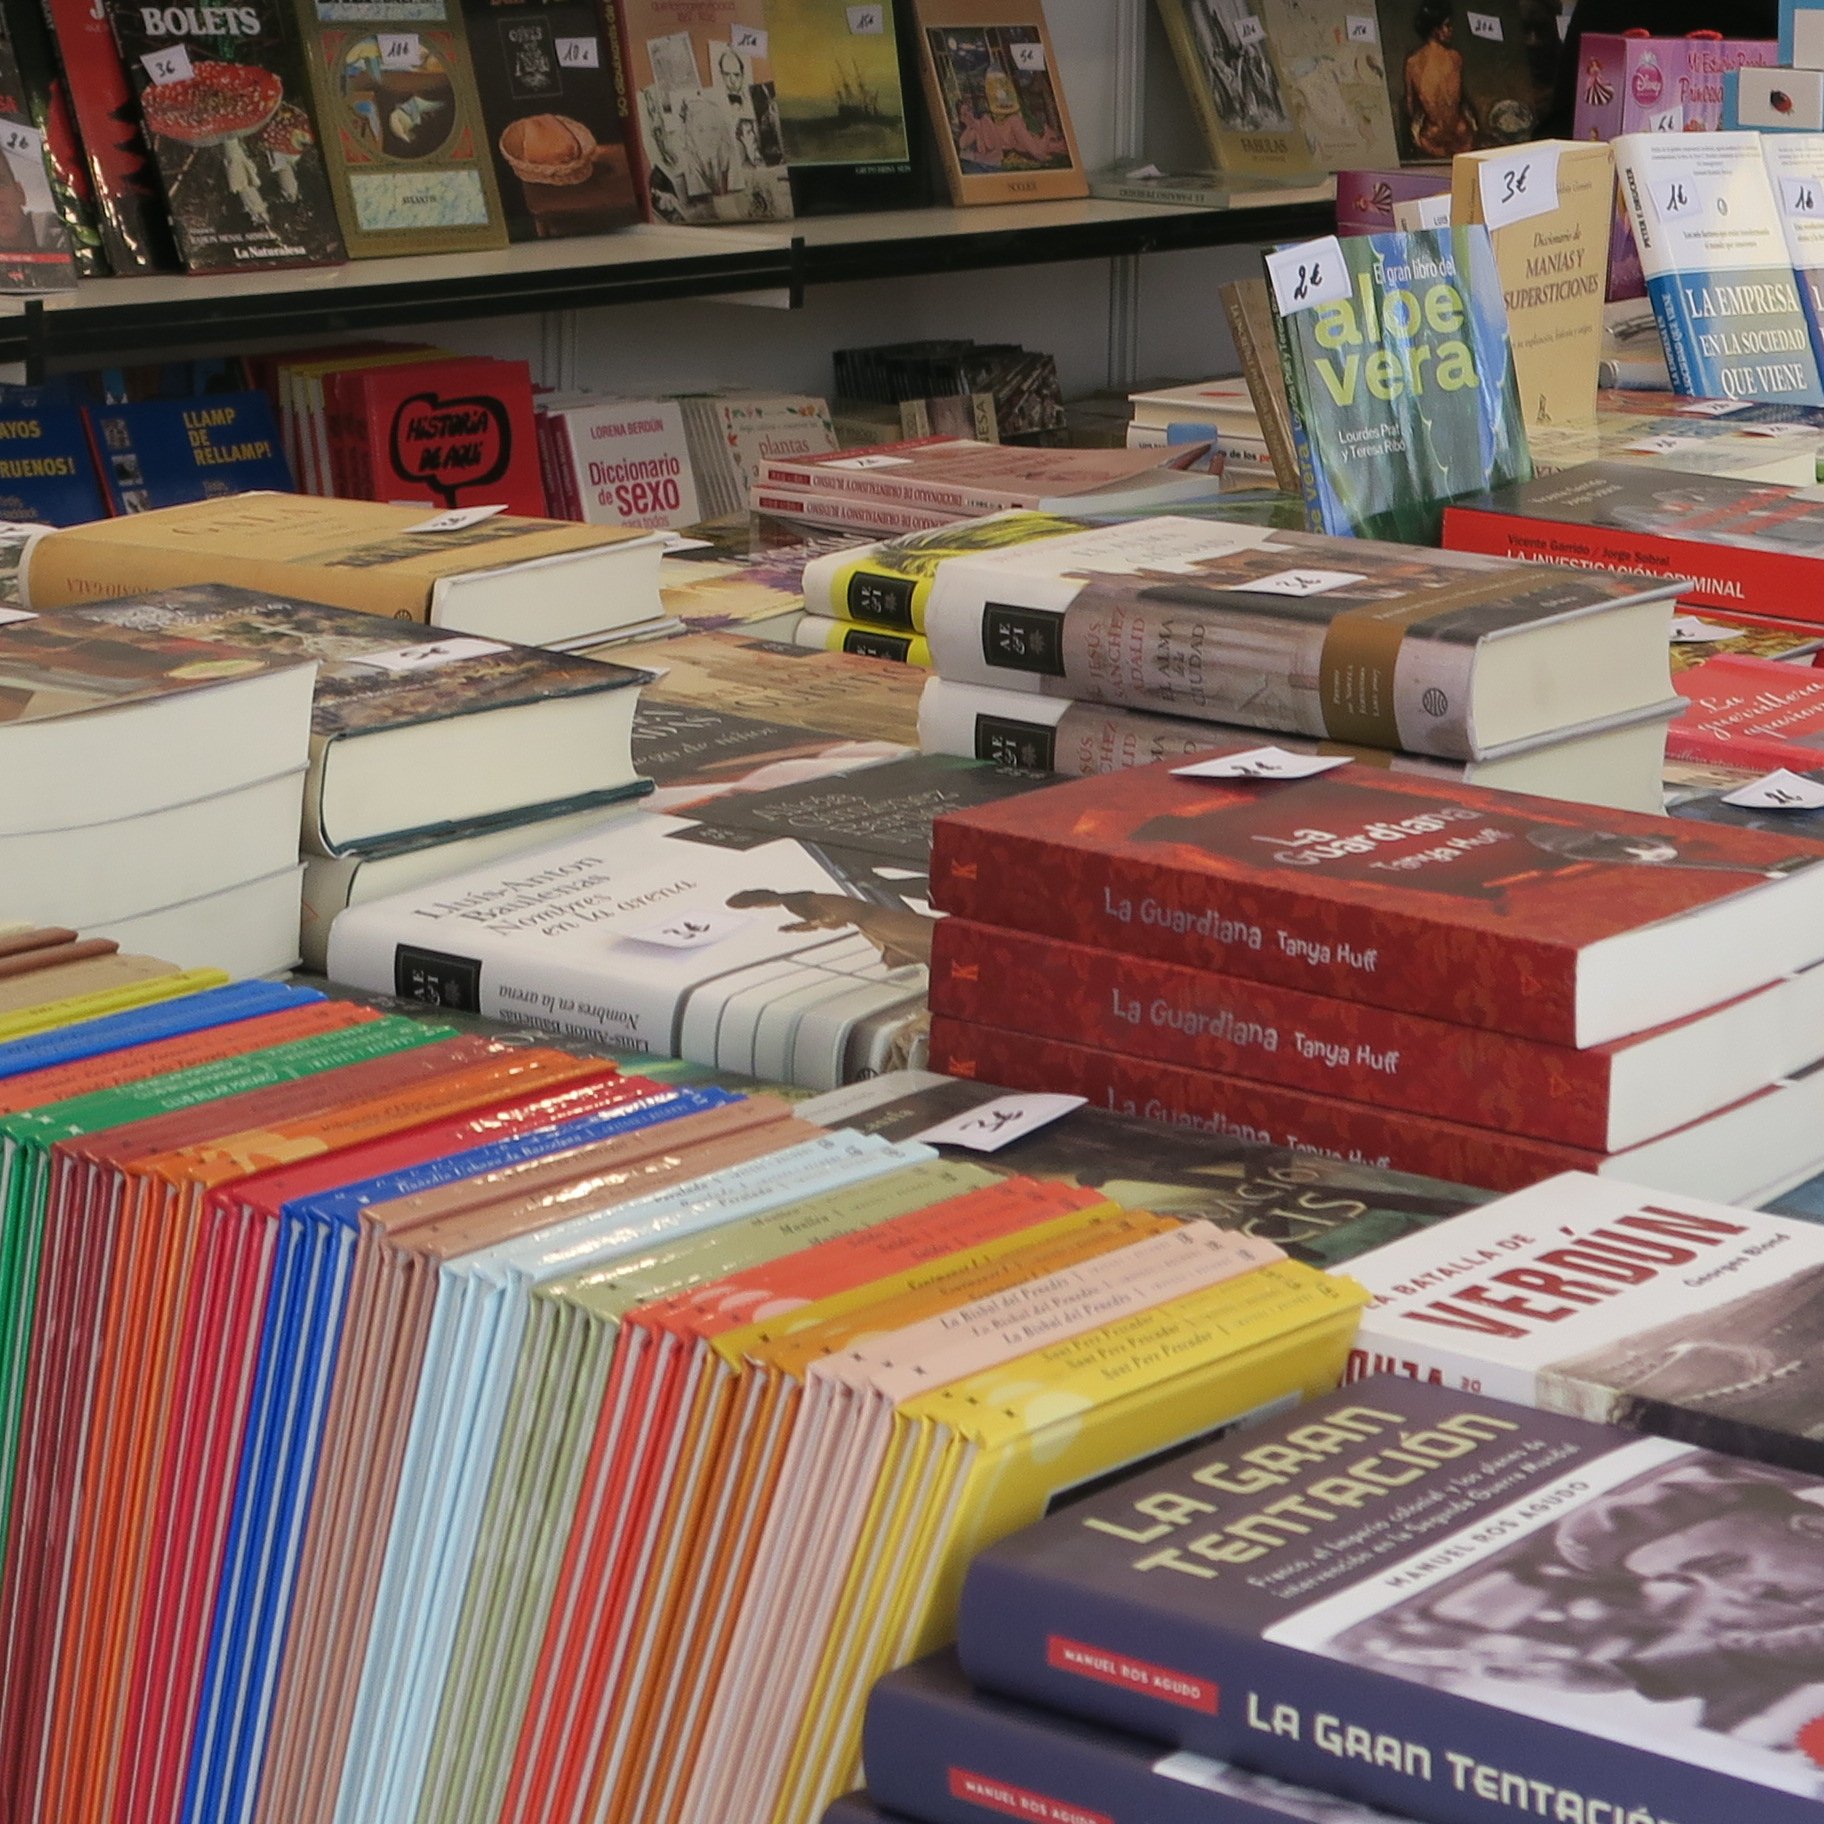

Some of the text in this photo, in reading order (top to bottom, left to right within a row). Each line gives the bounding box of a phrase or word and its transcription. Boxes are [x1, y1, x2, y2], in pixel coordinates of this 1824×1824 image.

[140, 6, 262, 38] BOLETS
[1501, 164, 1531, 204] 3€
[1293, 265, 1322, 300] 2€
[1503, 275, 1600, 312] SUPERSTICIONES
[1685, 282, 1801, 320] LA EMPRESA
[1313, 272, 1465, 350] aloe
[1733, 327, 1808, 354] SOCIEDAD
[1312, 337, 1480, 408] vera
[1721, 363, 1808, 400] QUE VIENE
[182, 407, 235, 429] LLAMP
[589, 420, 627, 438] LORENA
[193, 440, 272, 466] RELLAMP!
[588, 454, 682, 487] Diccionario
[614, 478, 683, 514] sexo
[1103, 886, 1378, 973] La Guardiana Tanya Huff
[1111, 988, 1400, 1075] La Guardiana Tanya Huff
[1400, 1204, 1750, 1339] VERDÚN
[1404, 1233, 1536, 1296] BATALLA DE
[1081, 1491, 1219, 1545] LA
[1192, 1405, 1408, 1494] GRAN
[1132, 1412, 1521, 1580] TENTACIÓN
[1247, 1690, 1432, 1781] LA GRAN
